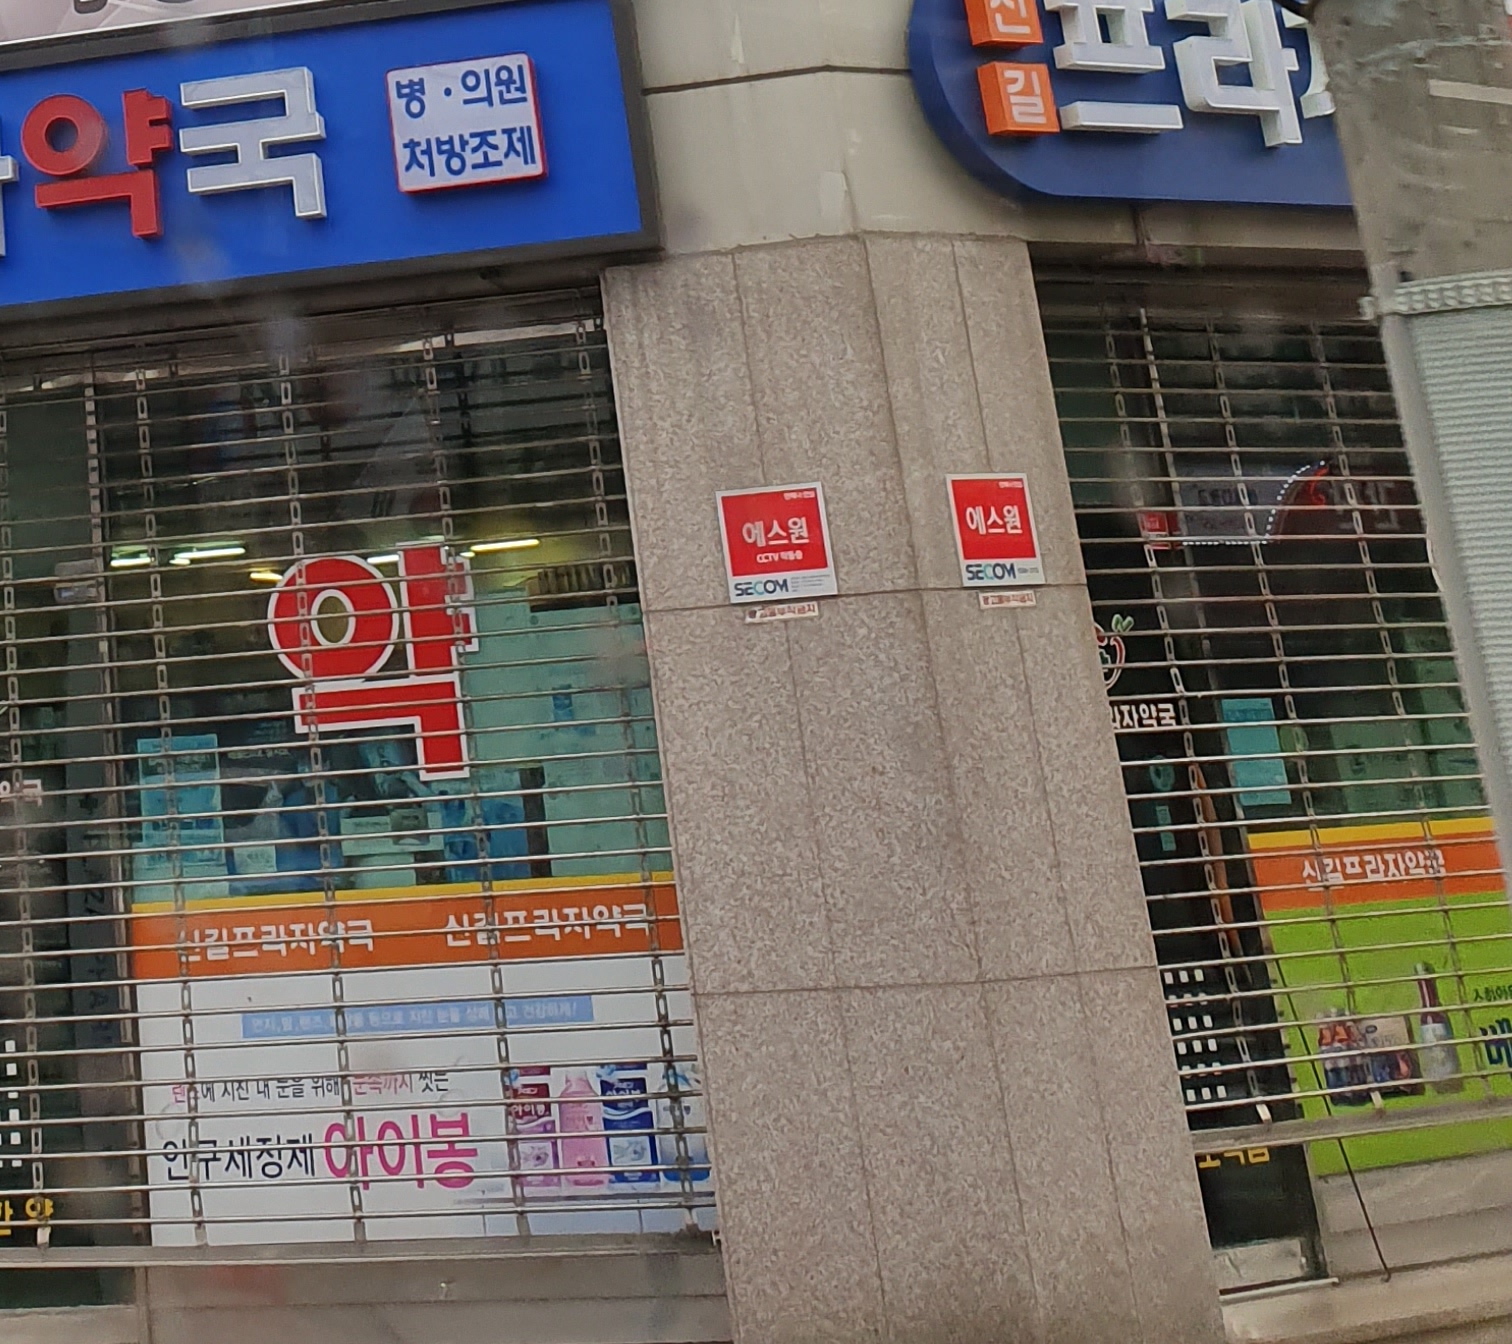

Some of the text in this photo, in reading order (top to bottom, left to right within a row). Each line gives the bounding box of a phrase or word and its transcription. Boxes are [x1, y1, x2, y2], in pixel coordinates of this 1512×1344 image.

[400, 123, 538, 181] 처방조제
[741, 517, 810, 548] 에스원
[966, 505, 1023, 535] 에스원
[734, 578, 789, 597] SECOM
[965, 563, 1017, 581] SECOM
[267, 541, 479, 780] 약
[324, 1112, 478, 1191] 아이봉
